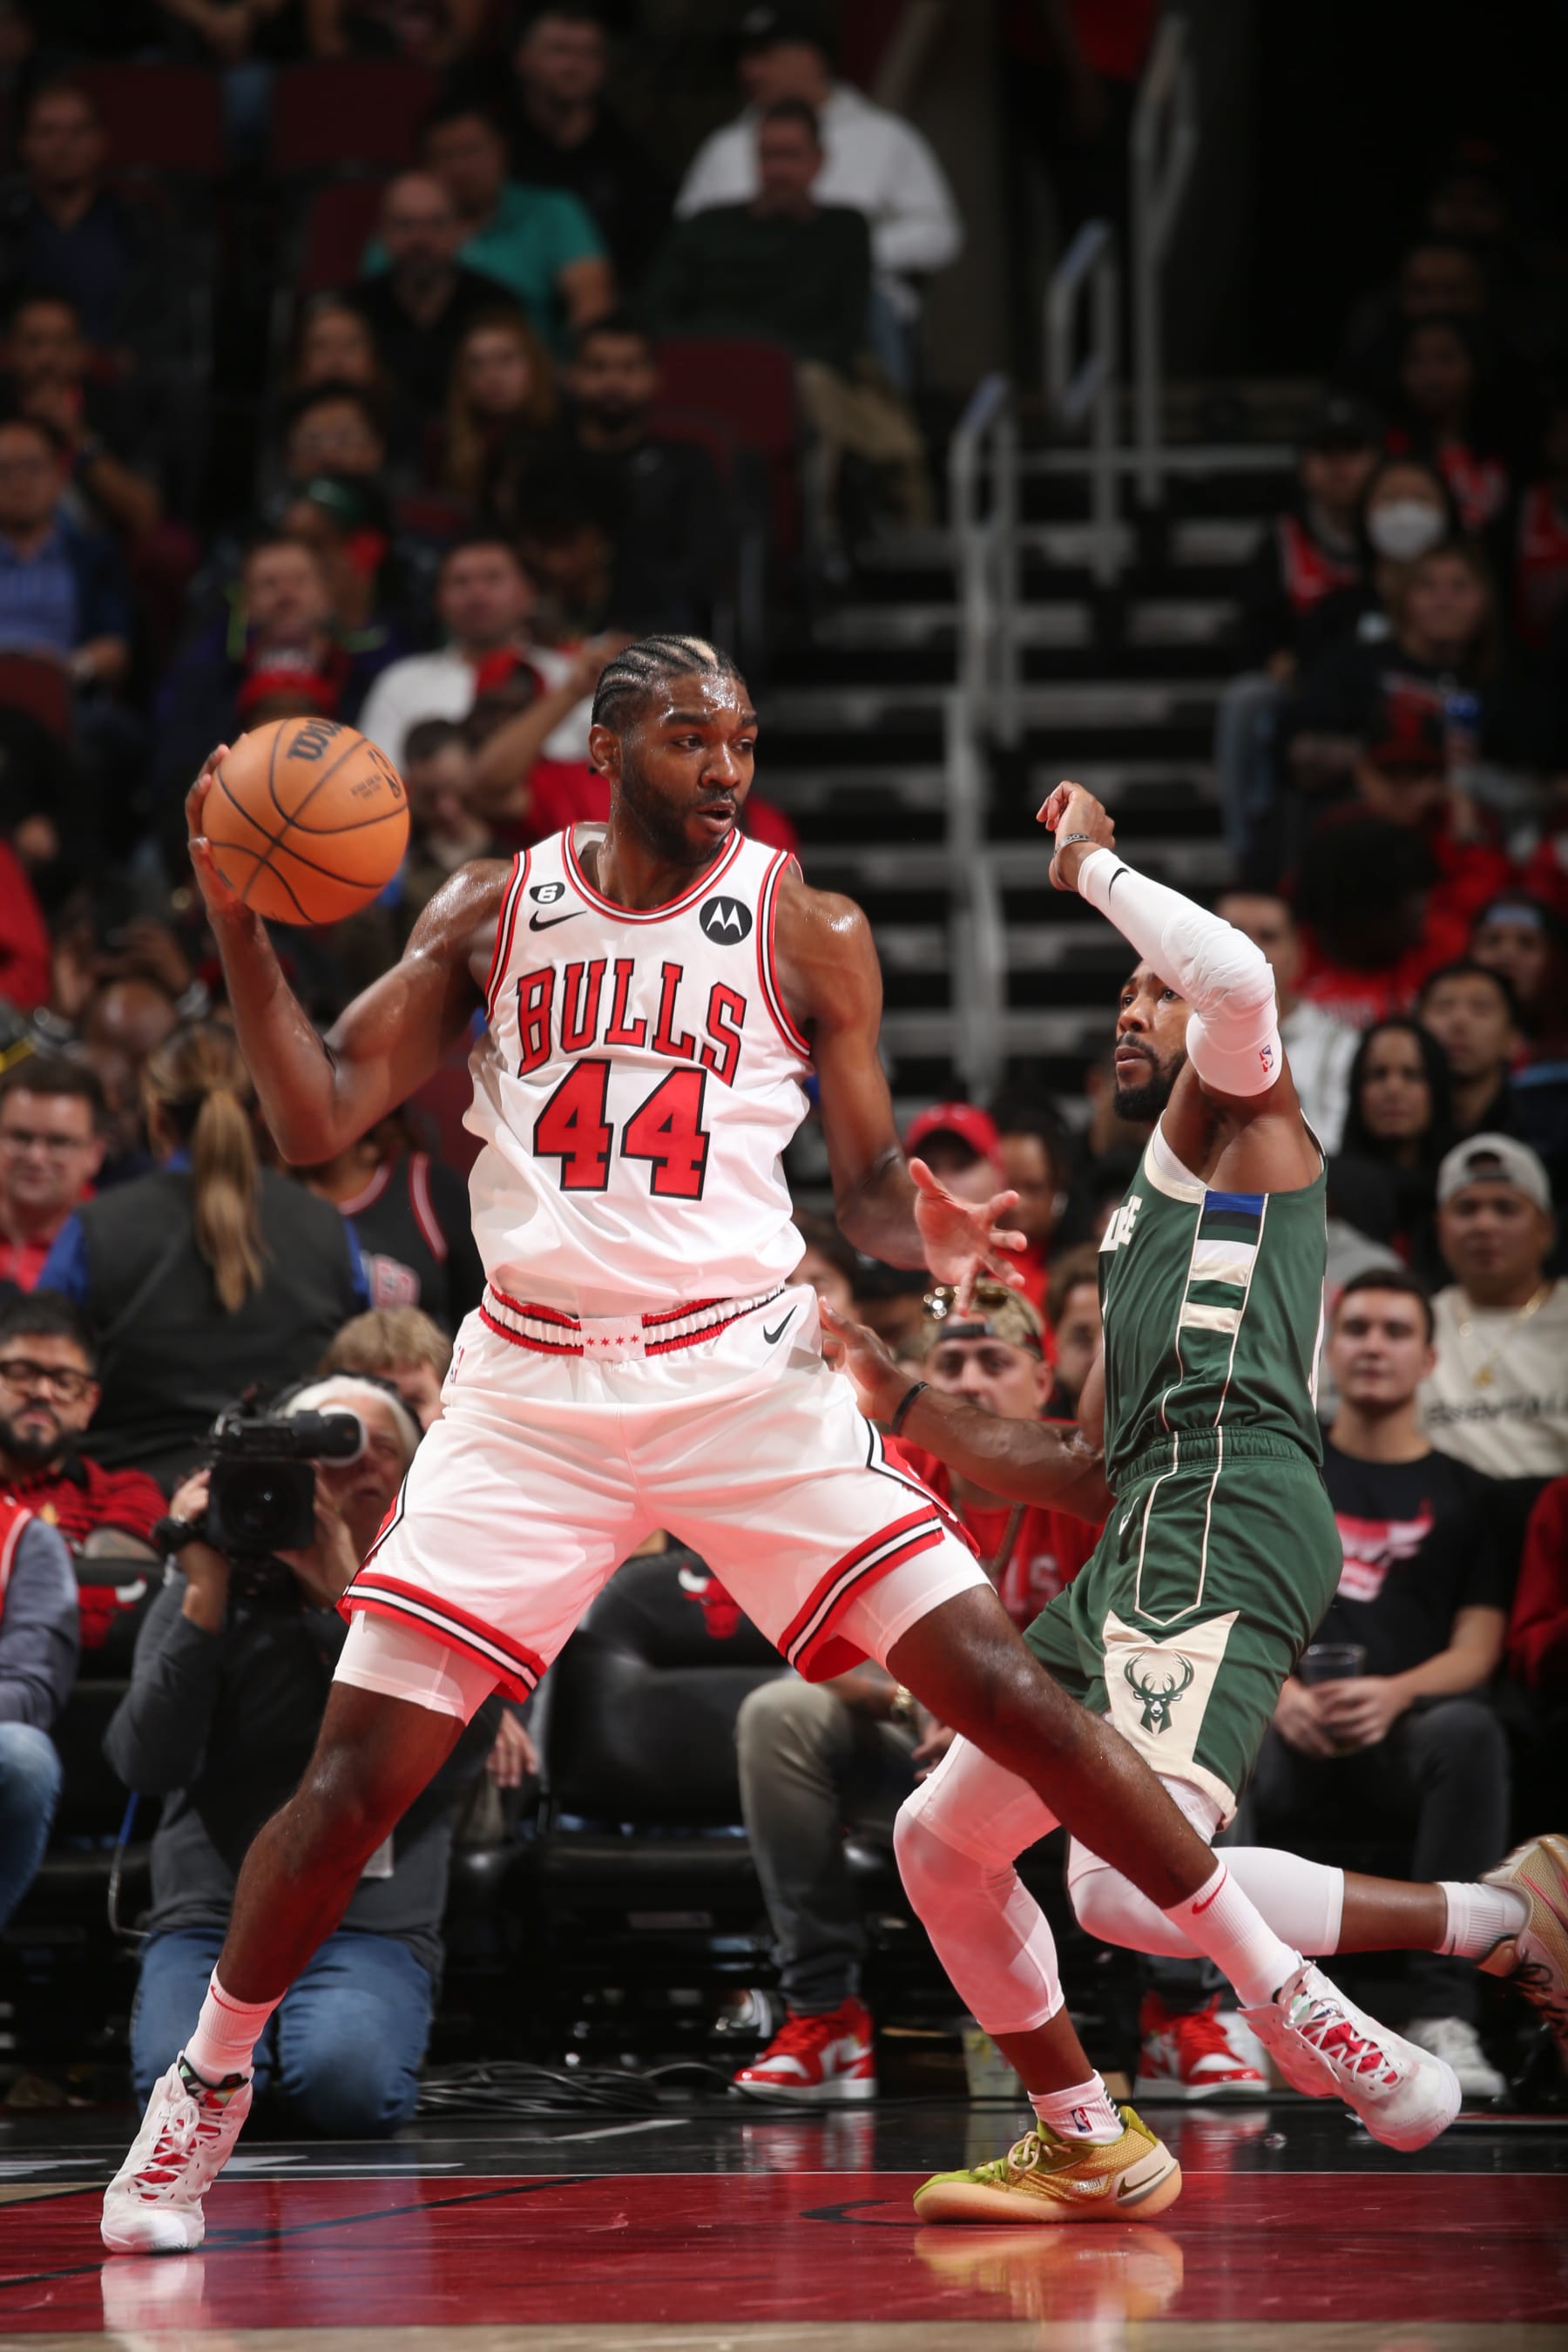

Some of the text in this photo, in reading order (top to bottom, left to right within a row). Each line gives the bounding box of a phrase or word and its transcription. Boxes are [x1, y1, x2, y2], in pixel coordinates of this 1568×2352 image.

[537, 885, 558, 903] 6
[516, 957, 747, 1088] BULLS
[533, 1058, 710, 1201] 44
